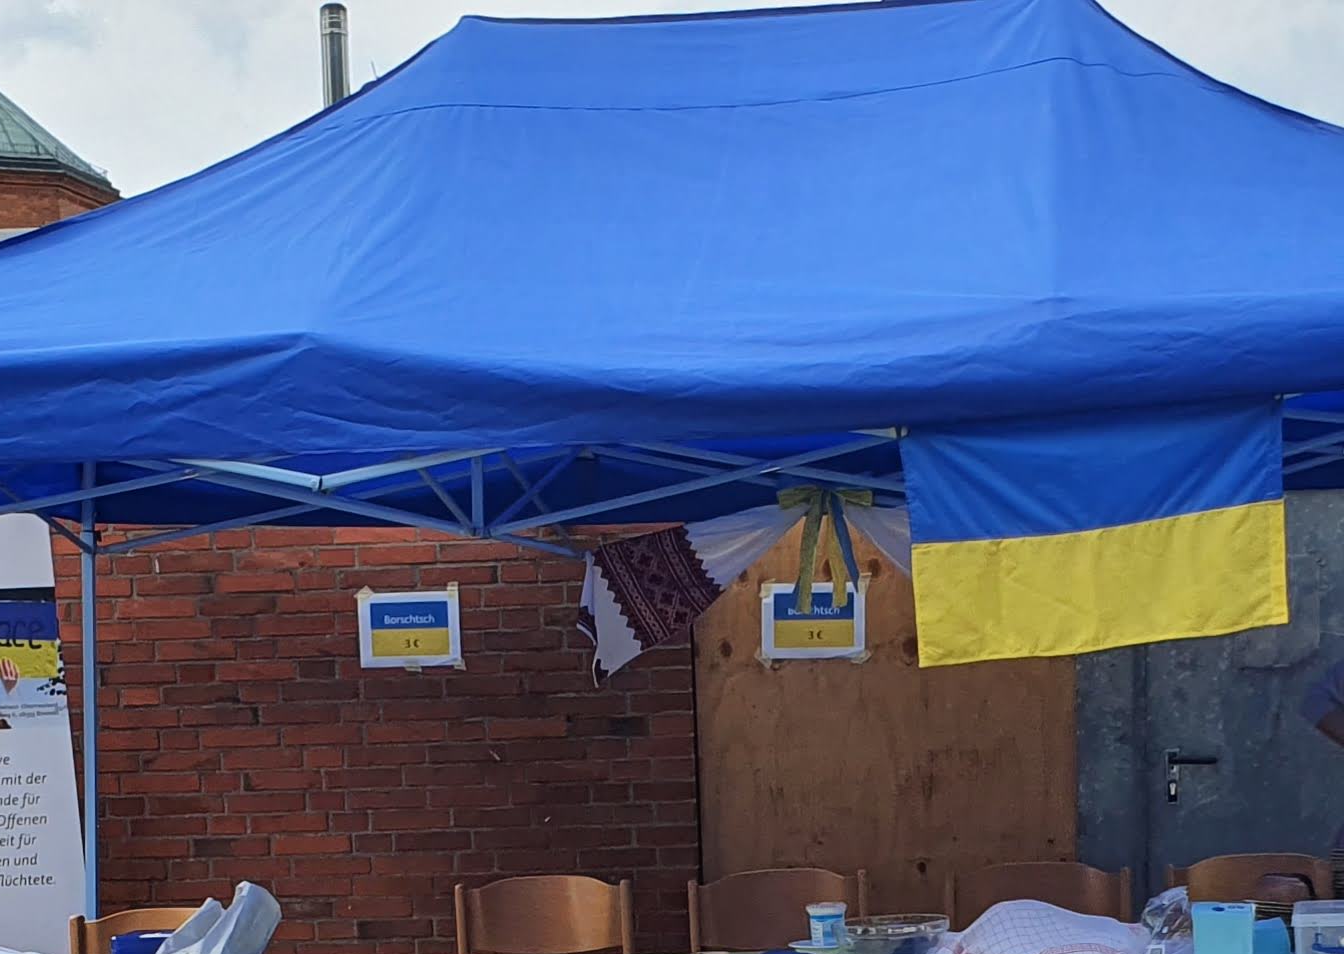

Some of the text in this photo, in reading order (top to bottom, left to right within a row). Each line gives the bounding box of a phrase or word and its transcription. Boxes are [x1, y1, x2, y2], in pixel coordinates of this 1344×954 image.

[383, 613, 435, 625] Borschtsch
[1, 773, 22, 786] mit
[25, 772, 47, 785] der
[20, 792, 41, 809] für
[16, 833, 37, 850] für
[14, 853, 38, 866] und
